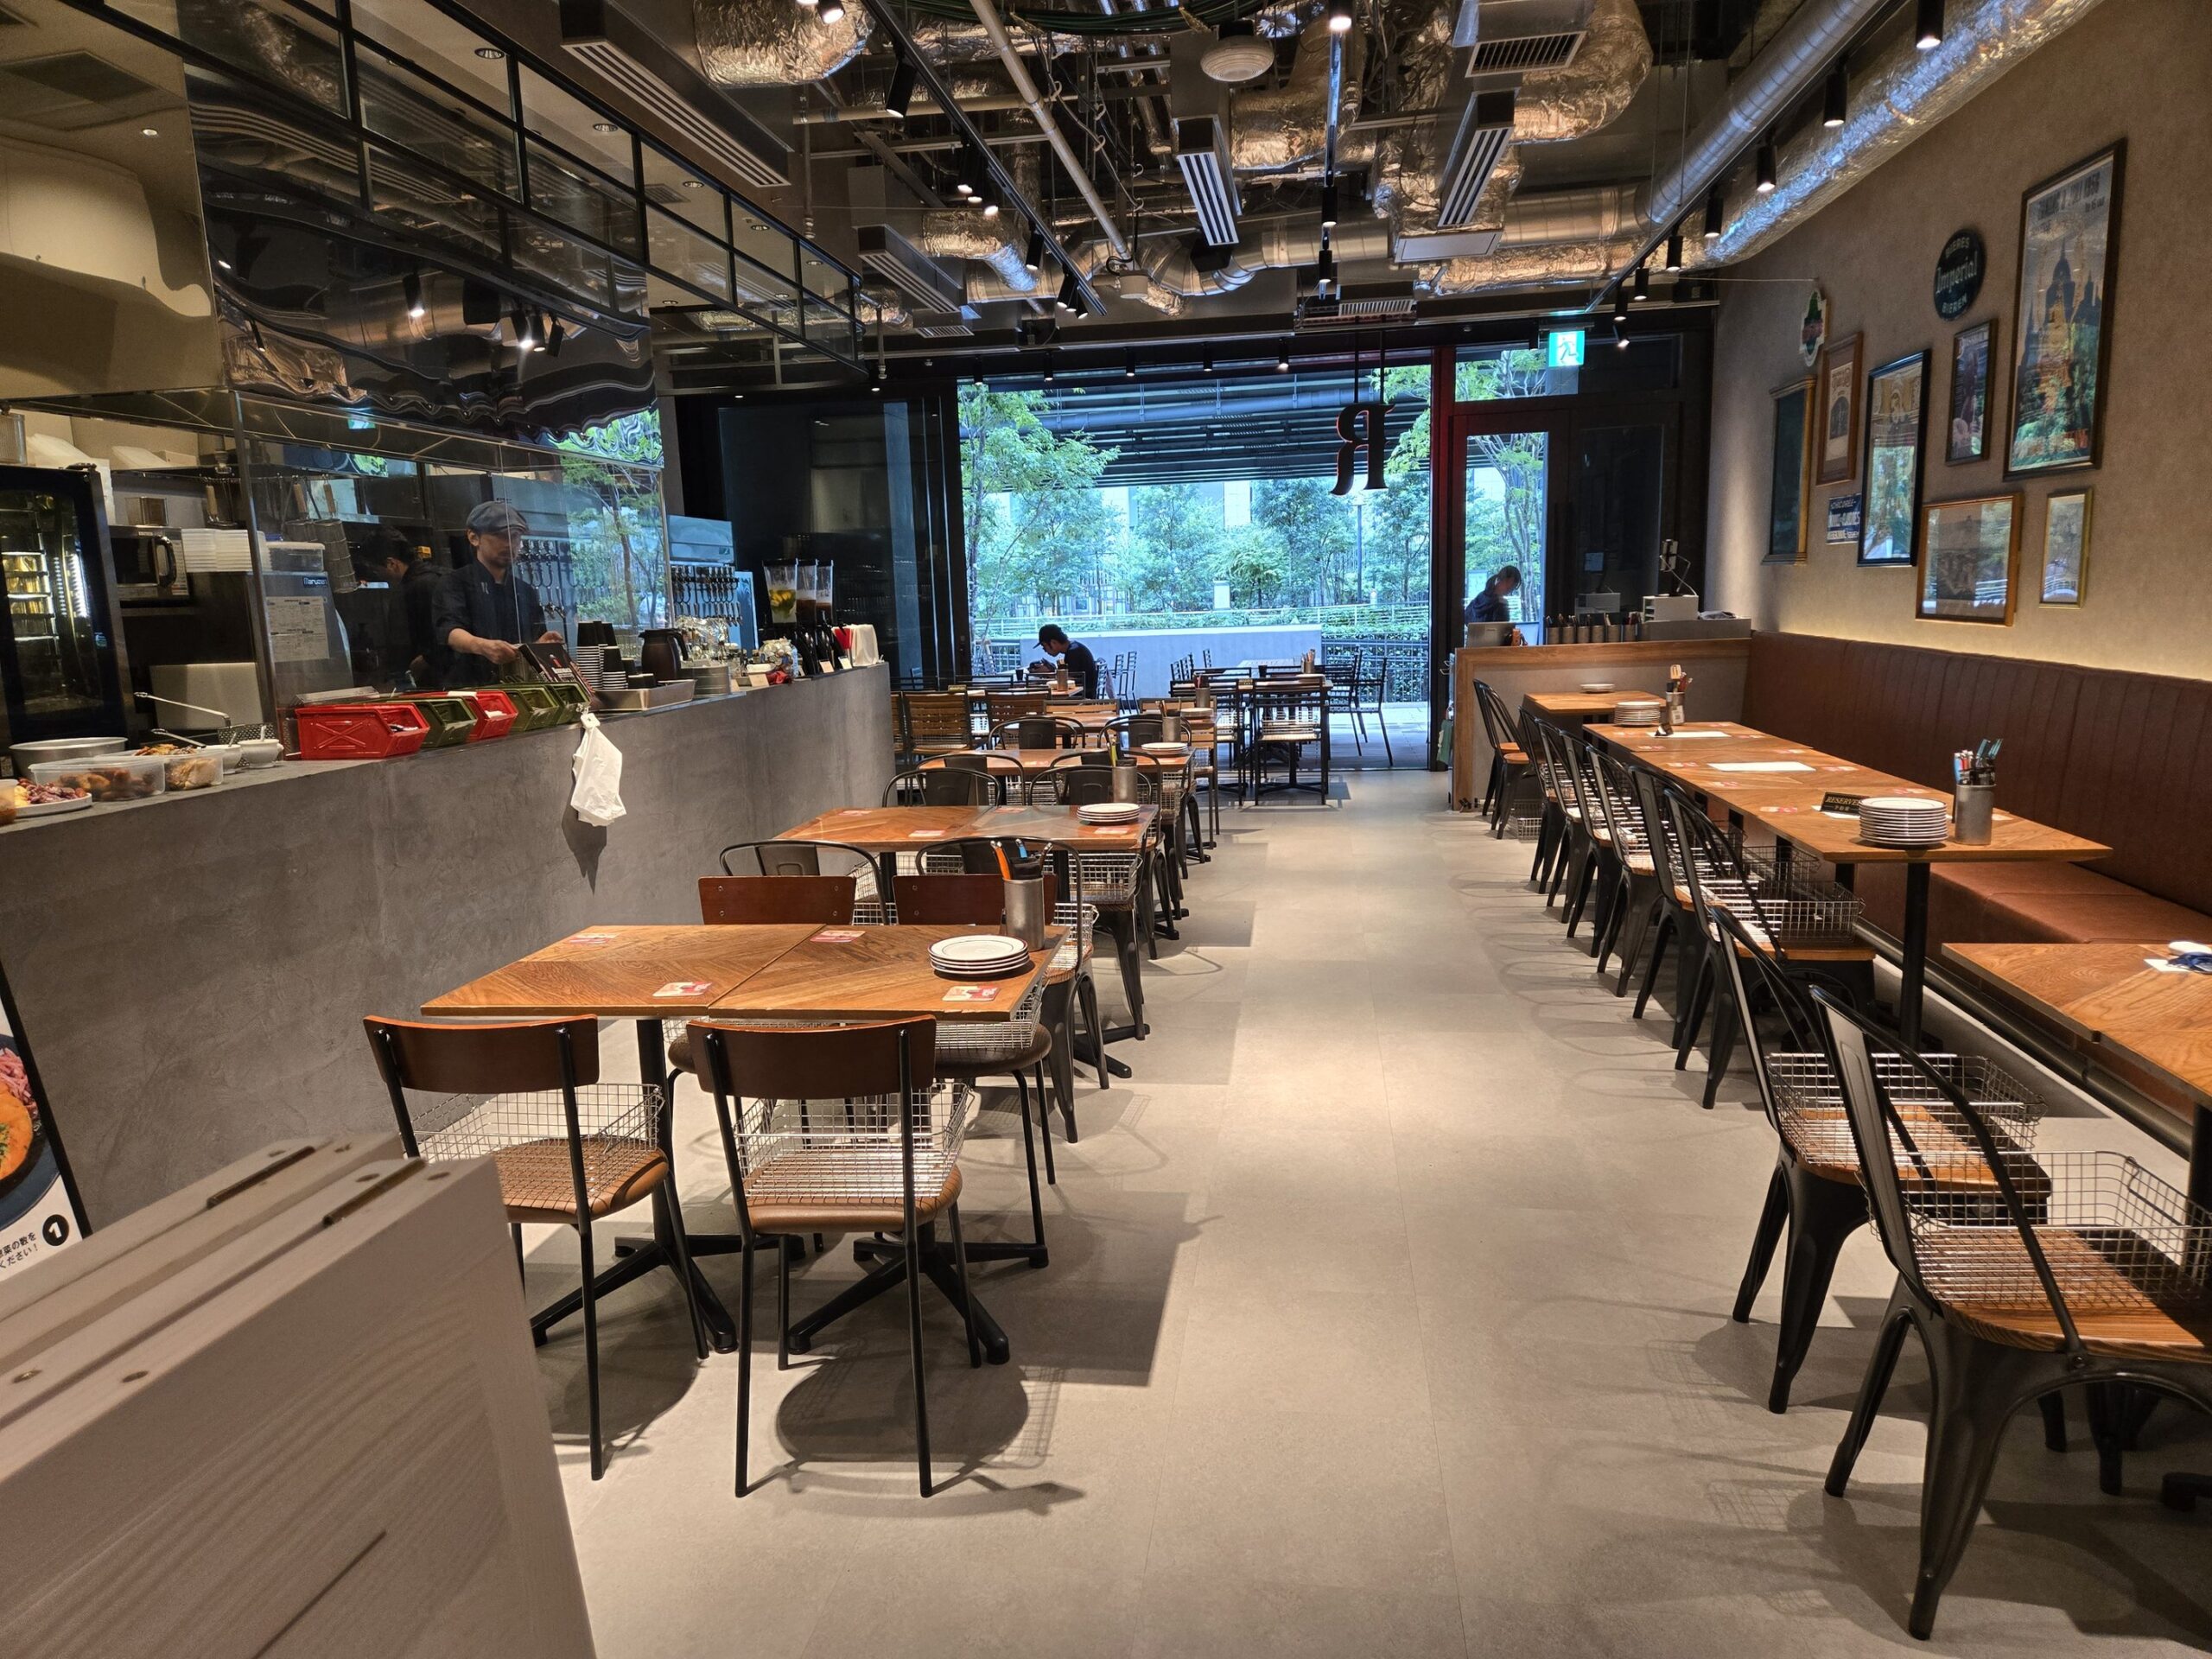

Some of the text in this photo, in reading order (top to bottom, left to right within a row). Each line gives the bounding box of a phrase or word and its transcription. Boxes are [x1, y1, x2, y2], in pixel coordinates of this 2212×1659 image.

[1935, 251, 1978, 295] Imperial
[1942, 293, 1967, 314] BIEREN
[48, 1222, 62, 1239] 1
